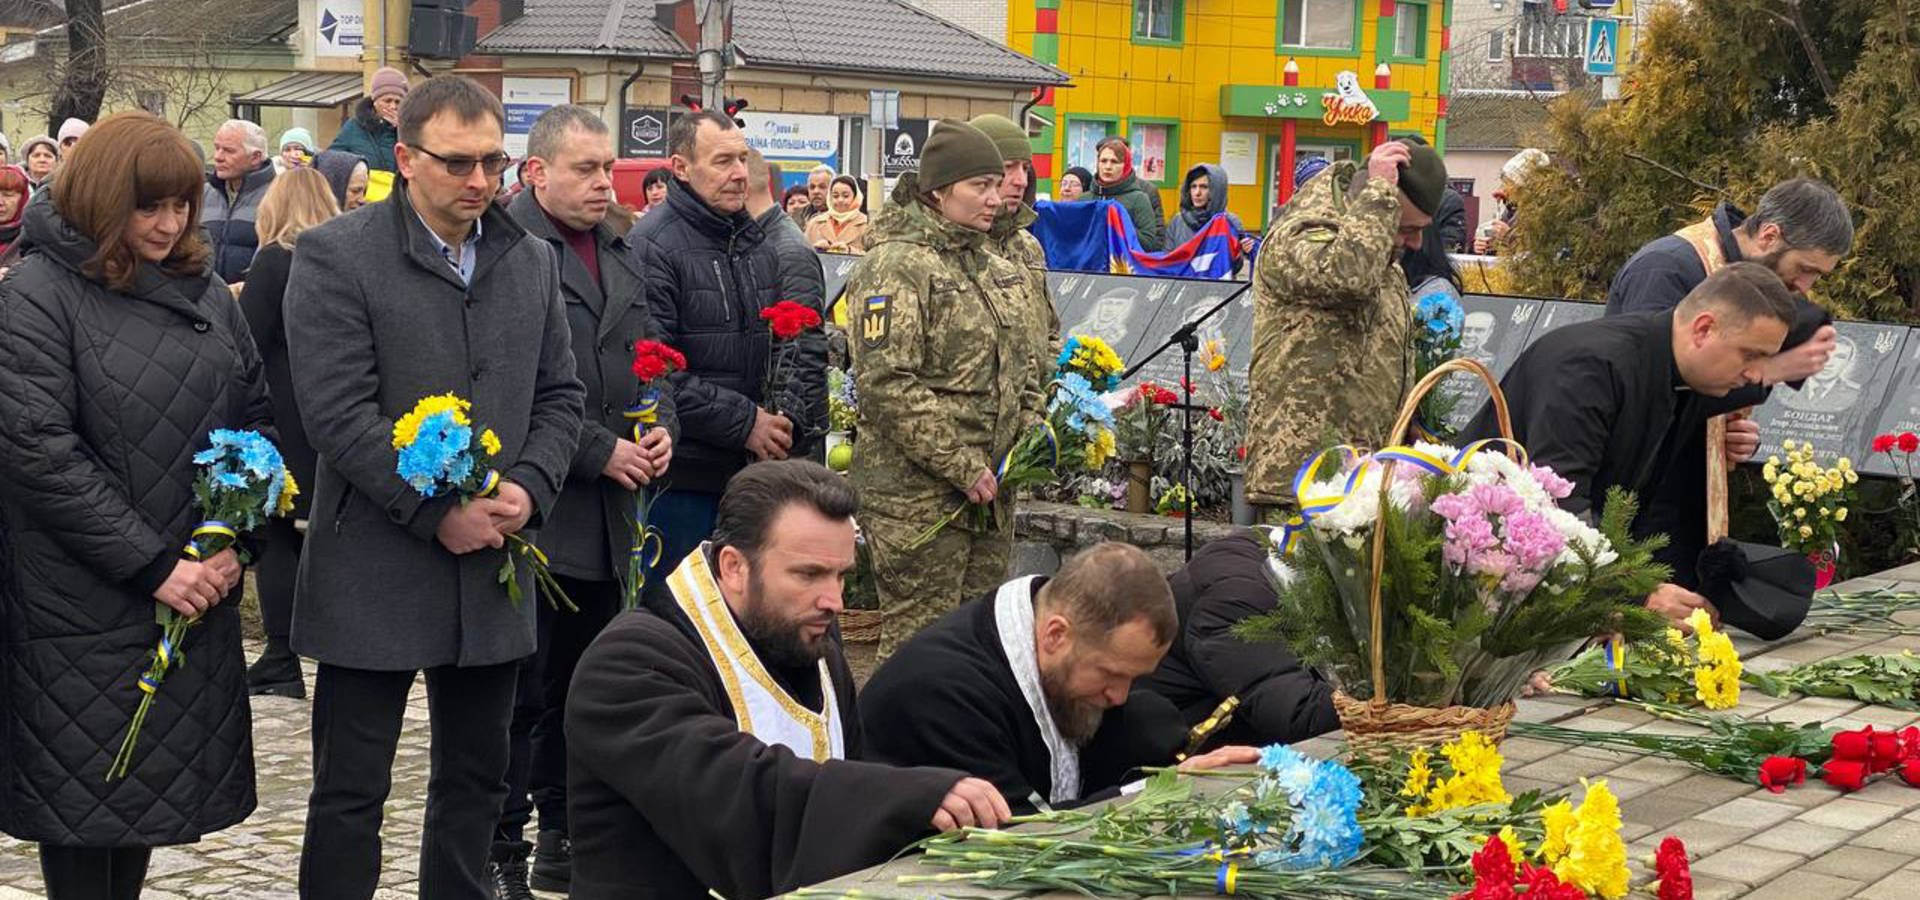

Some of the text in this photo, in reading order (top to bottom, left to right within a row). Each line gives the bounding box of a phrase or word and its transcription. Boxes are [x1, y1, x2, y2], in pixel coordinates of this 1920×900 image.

[1323, 95, 1372, 125] Умка
[744, 135, 831, 151] РАЇНА-ПОЛЬЩА-ЧЕХІЯ
[1783, 410, 1835, 422] БОНДАР
